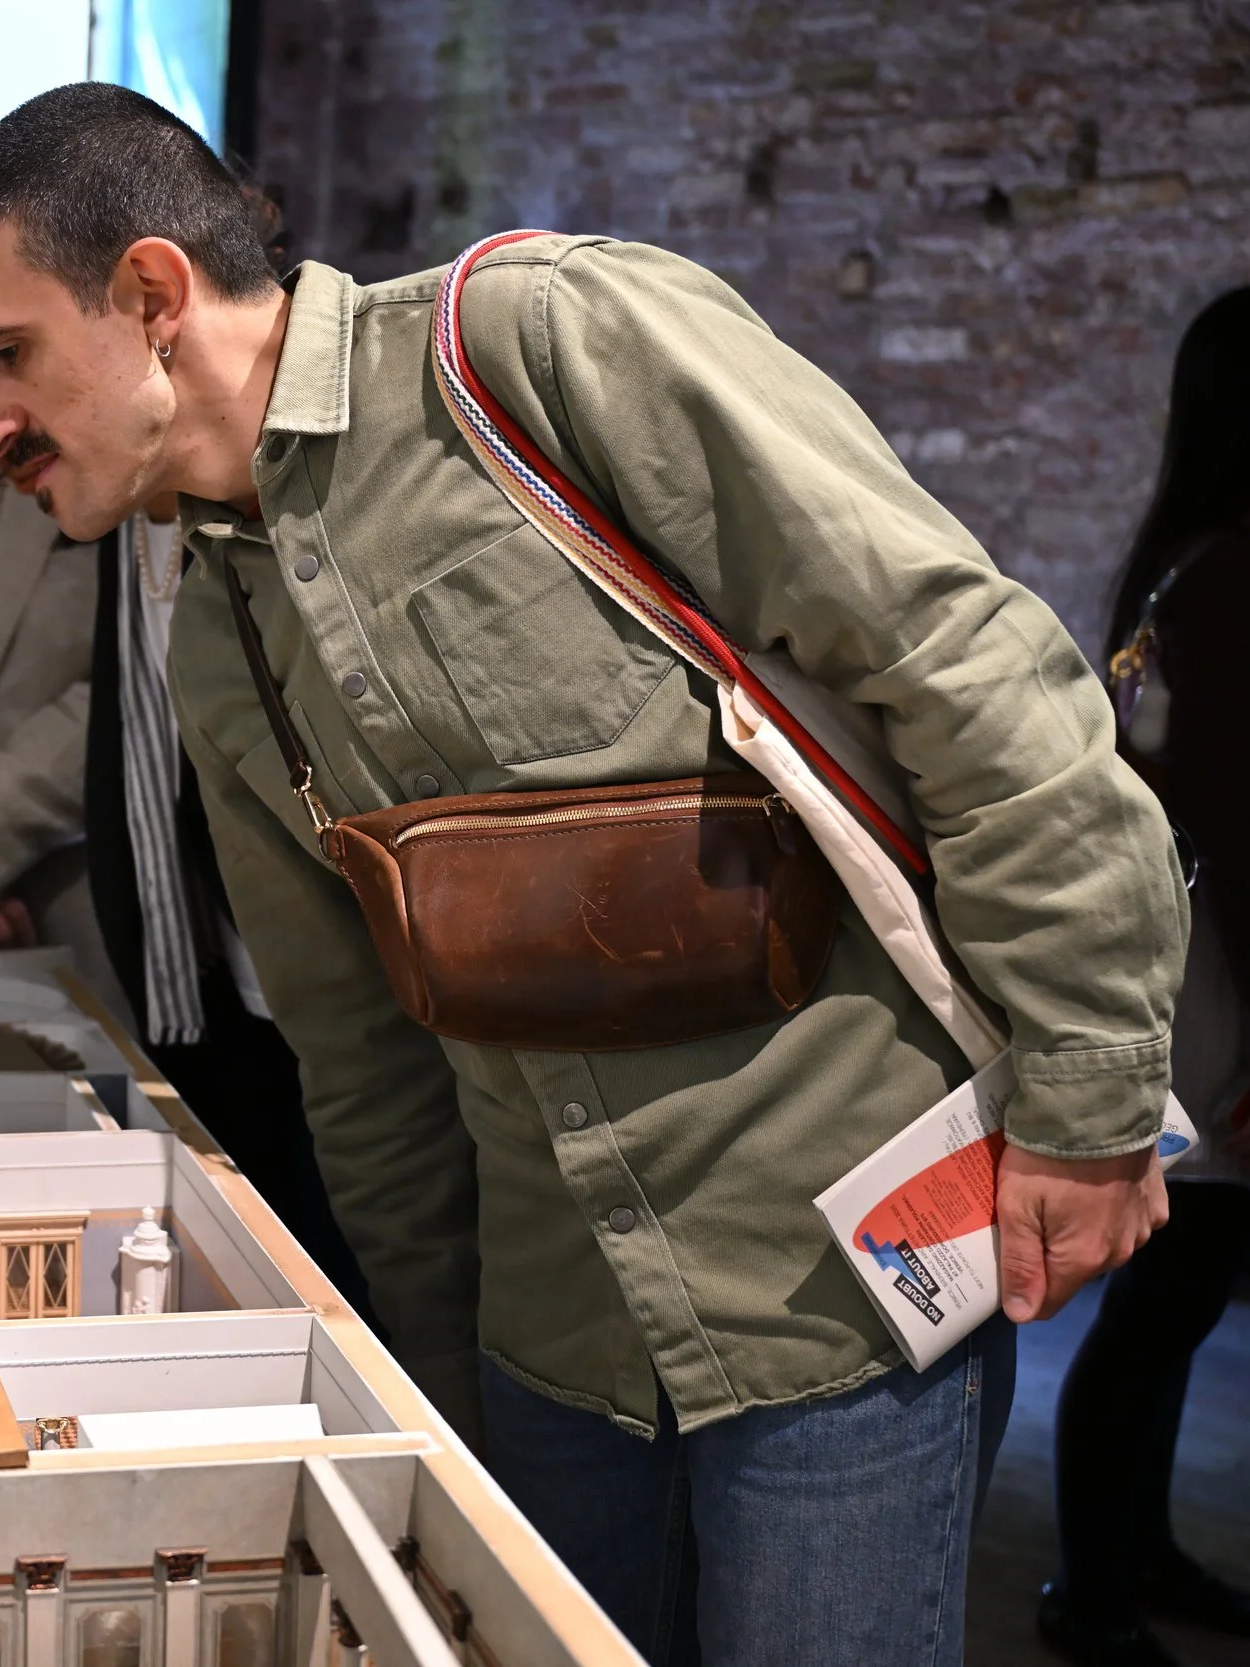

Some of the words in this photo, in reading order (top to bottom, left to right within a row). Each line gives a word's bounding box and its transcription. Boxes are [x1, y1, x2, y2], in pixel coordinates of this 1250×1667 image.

[900, 1247, 912, 1258] IT
[934, 1246, 954, 1271] PALAZZO
[906, 1256, 935, 1291] ABOUT
[896, 1278, 928, 1309] DOUBT
[924, 1305, 941, 1322] NO
